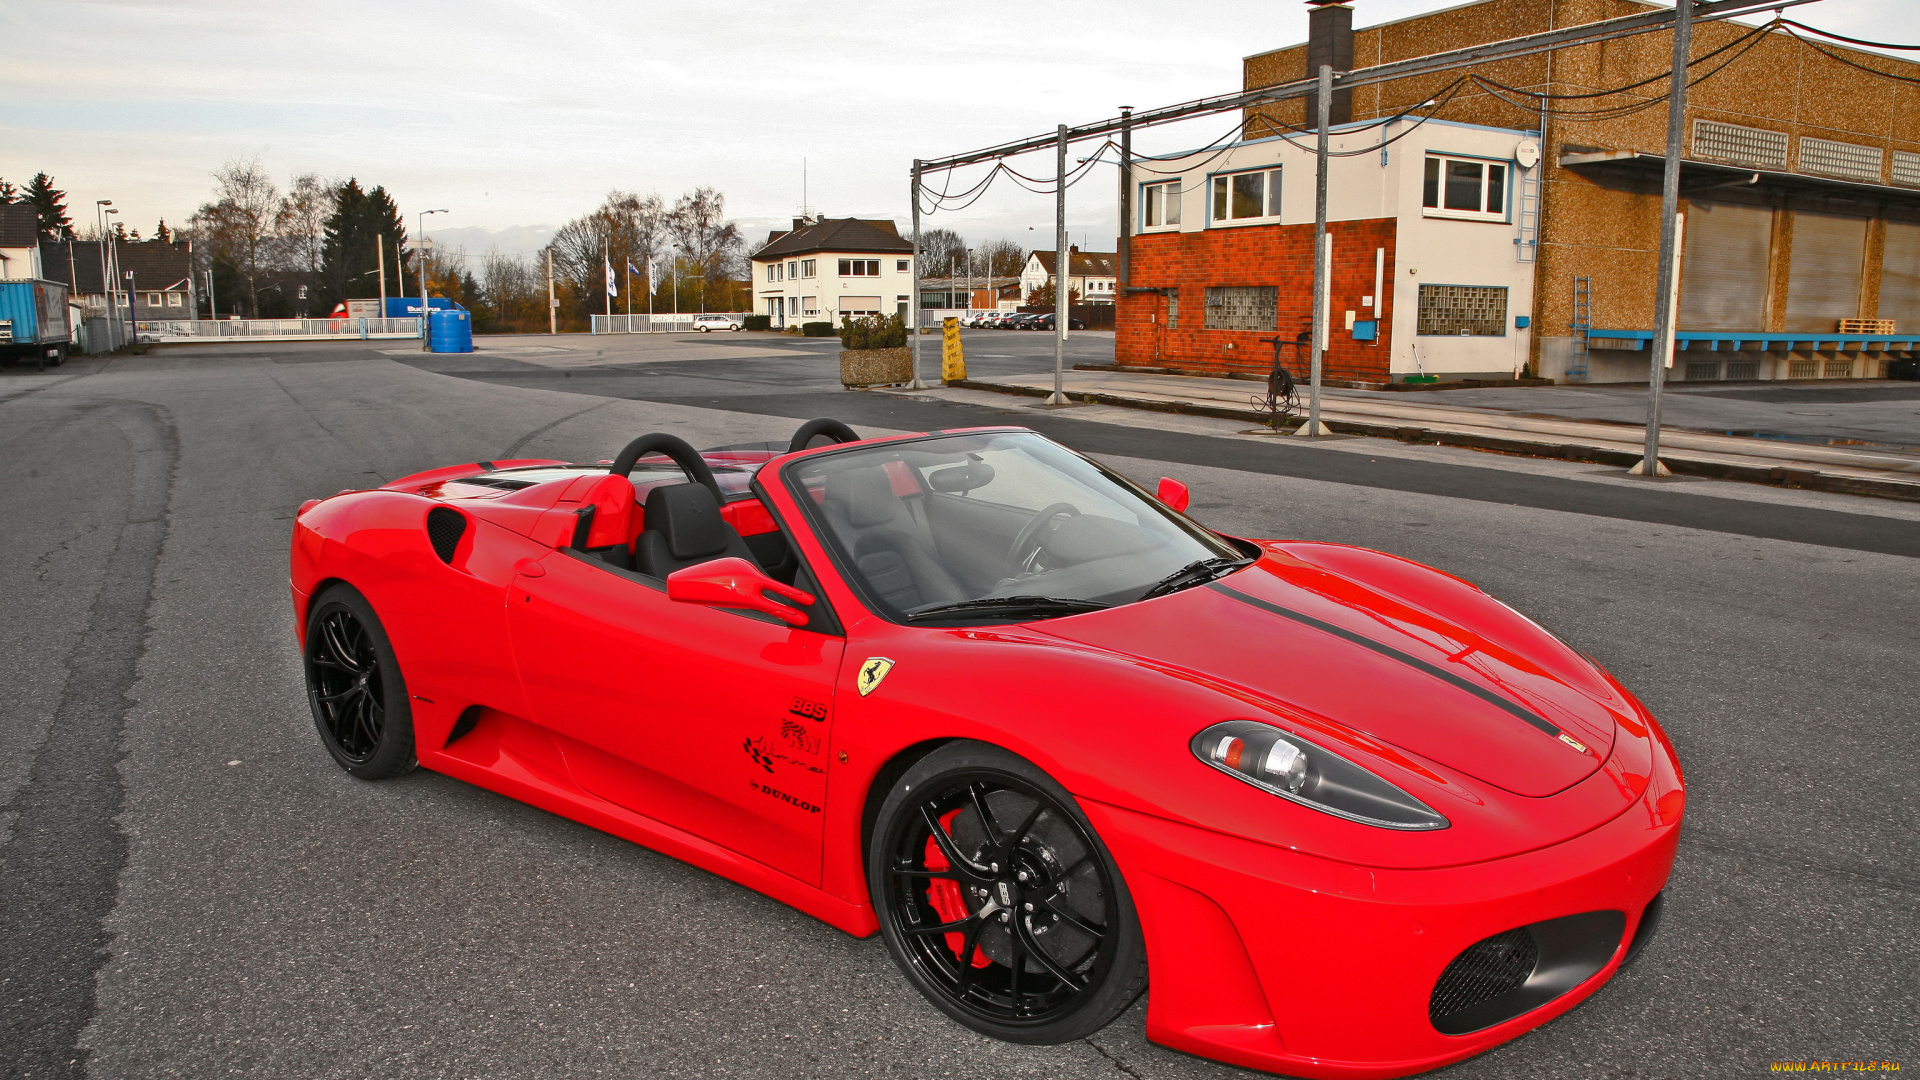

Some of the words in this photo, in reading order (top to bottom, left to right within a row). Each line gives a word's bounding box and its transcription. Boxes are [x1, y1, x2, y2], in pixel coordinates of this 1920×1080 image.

[789, 696, 827, 722] BBS
[761, 785, 821, 814] DUNLOP
[998, 882, 1011, 905] BBS
